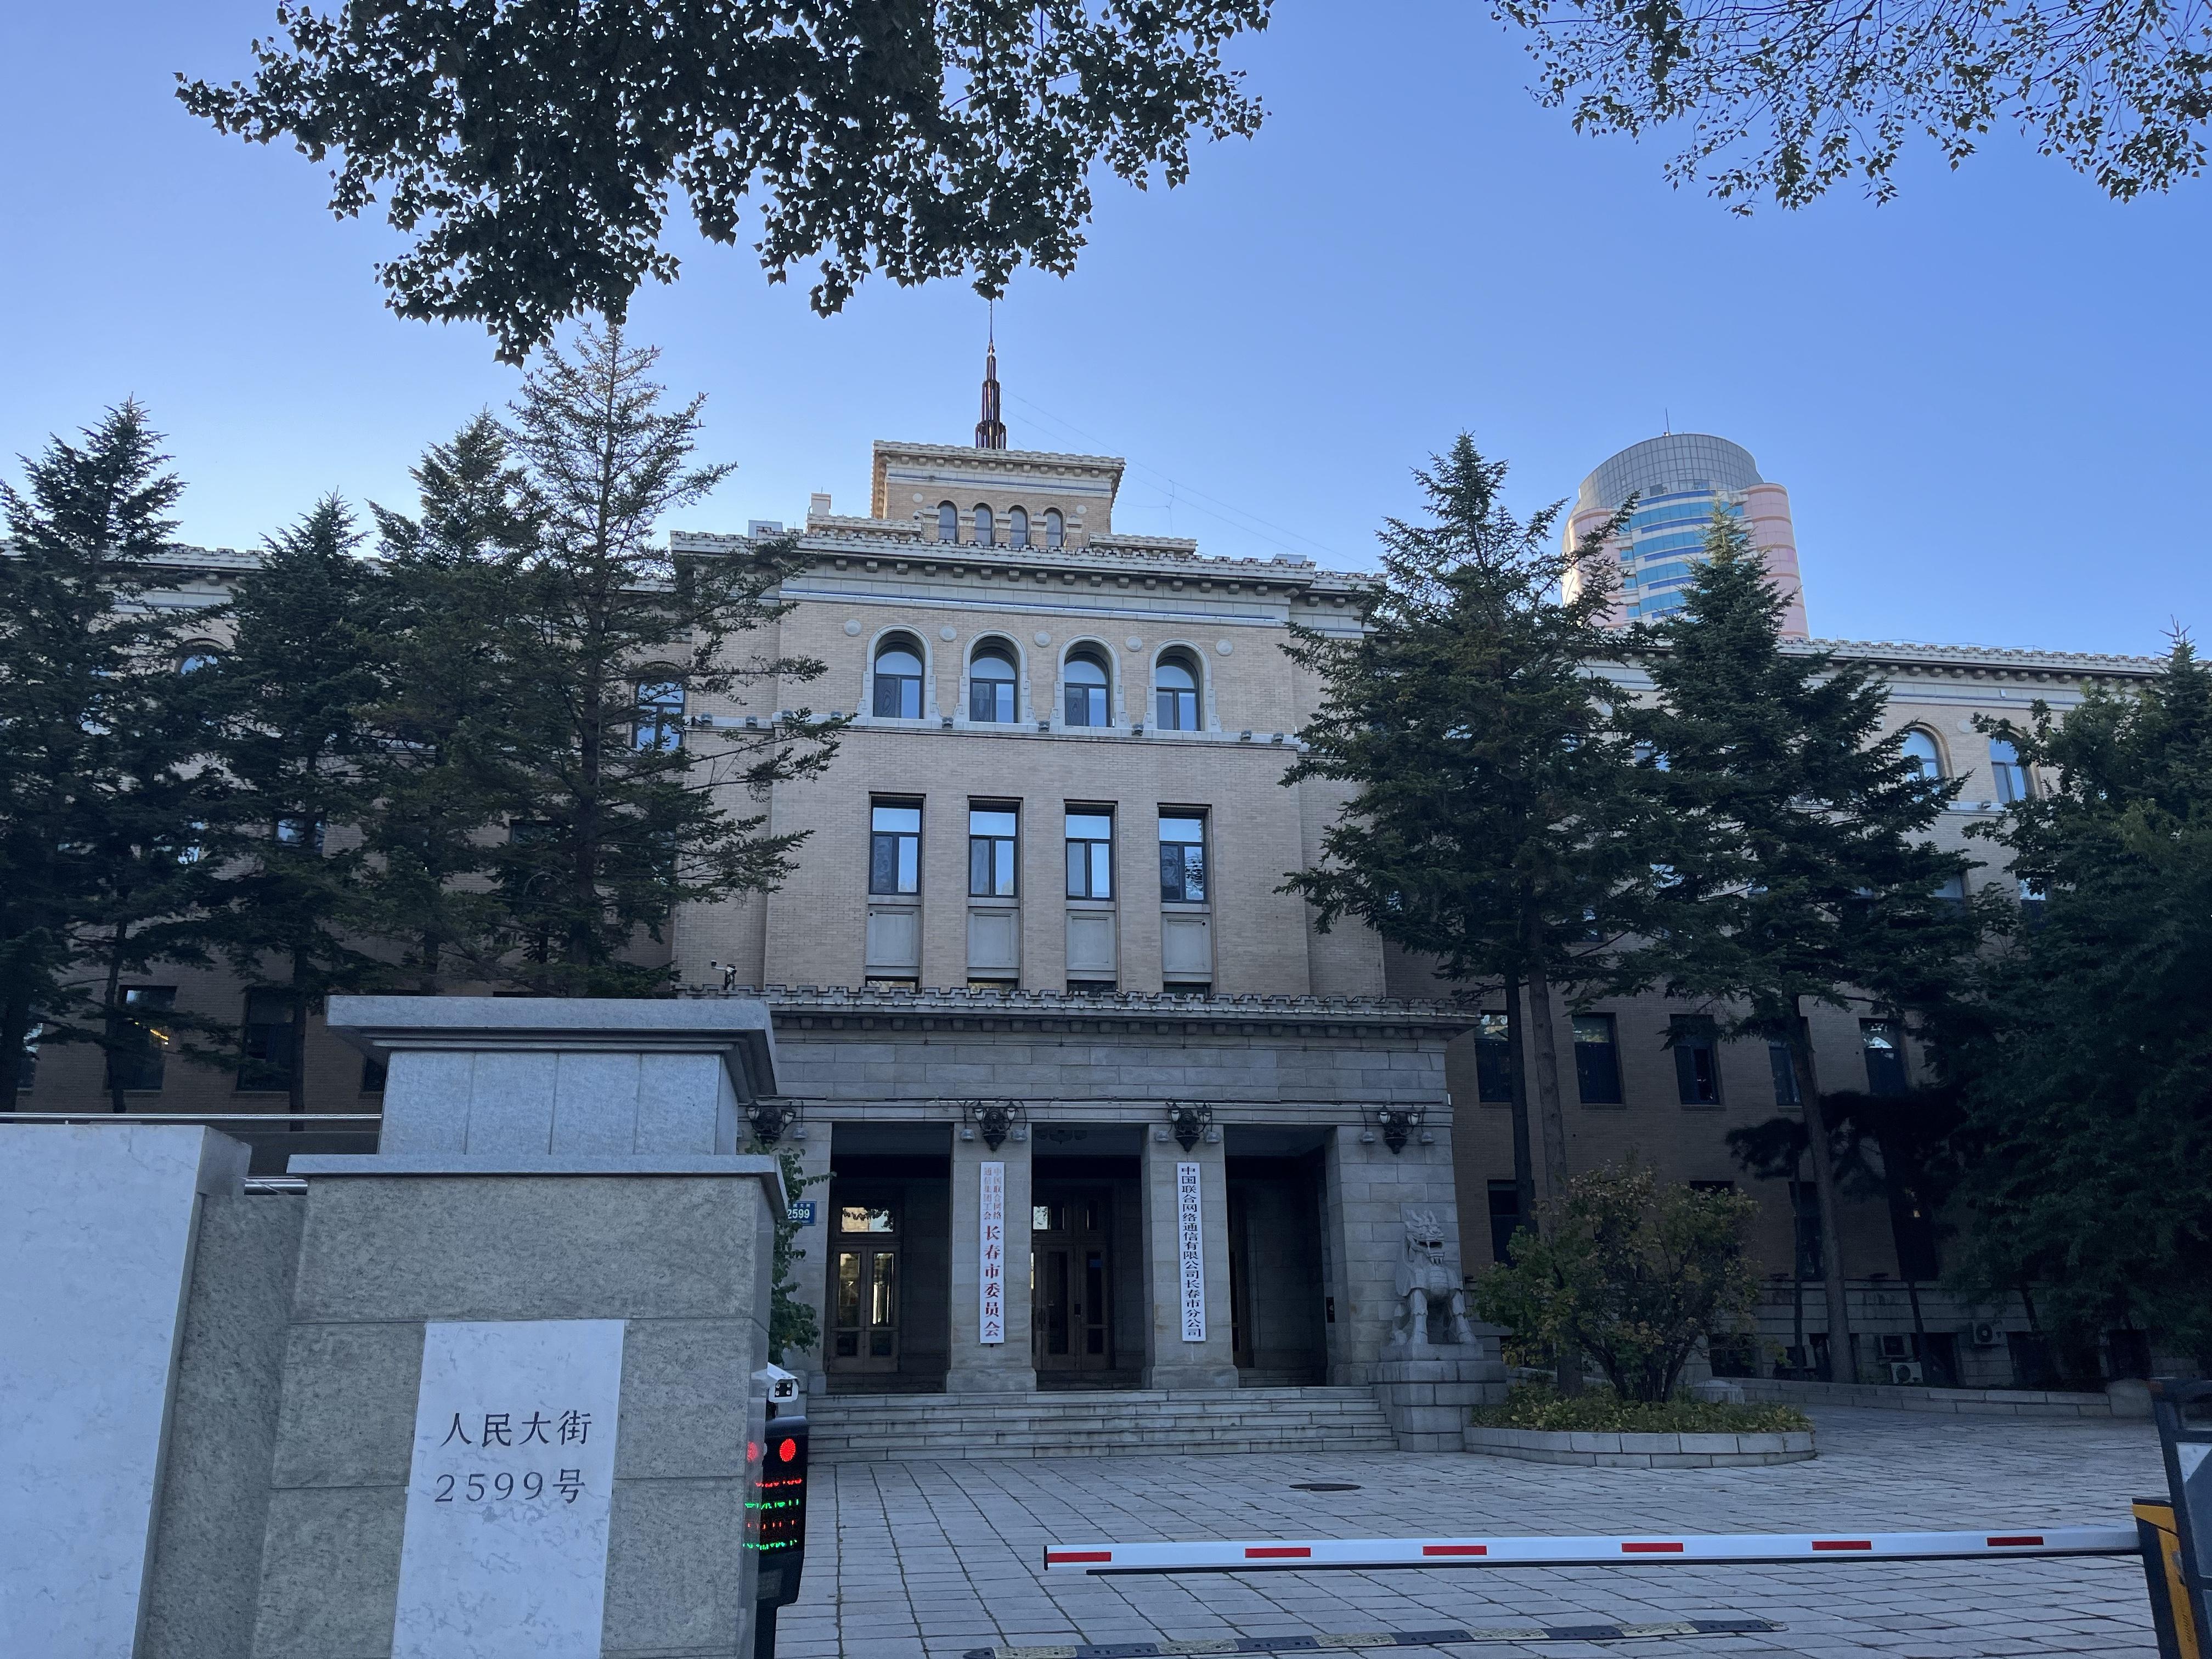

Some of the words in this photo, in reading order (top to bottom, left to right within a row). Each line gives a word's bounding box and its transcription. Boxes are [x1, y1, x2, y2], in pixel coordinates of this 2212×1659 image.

[787, 1209, 810, 1219] 2599
[1181, 1166, 1201, 1337] 中国联合网络通信有限公司长春市分公司
[984, 1225, 1001, 1337] 长春市委员会
[440, 1409, 594, 1448] 人民大街
[435, 1468, 586, 1504] 2599号
